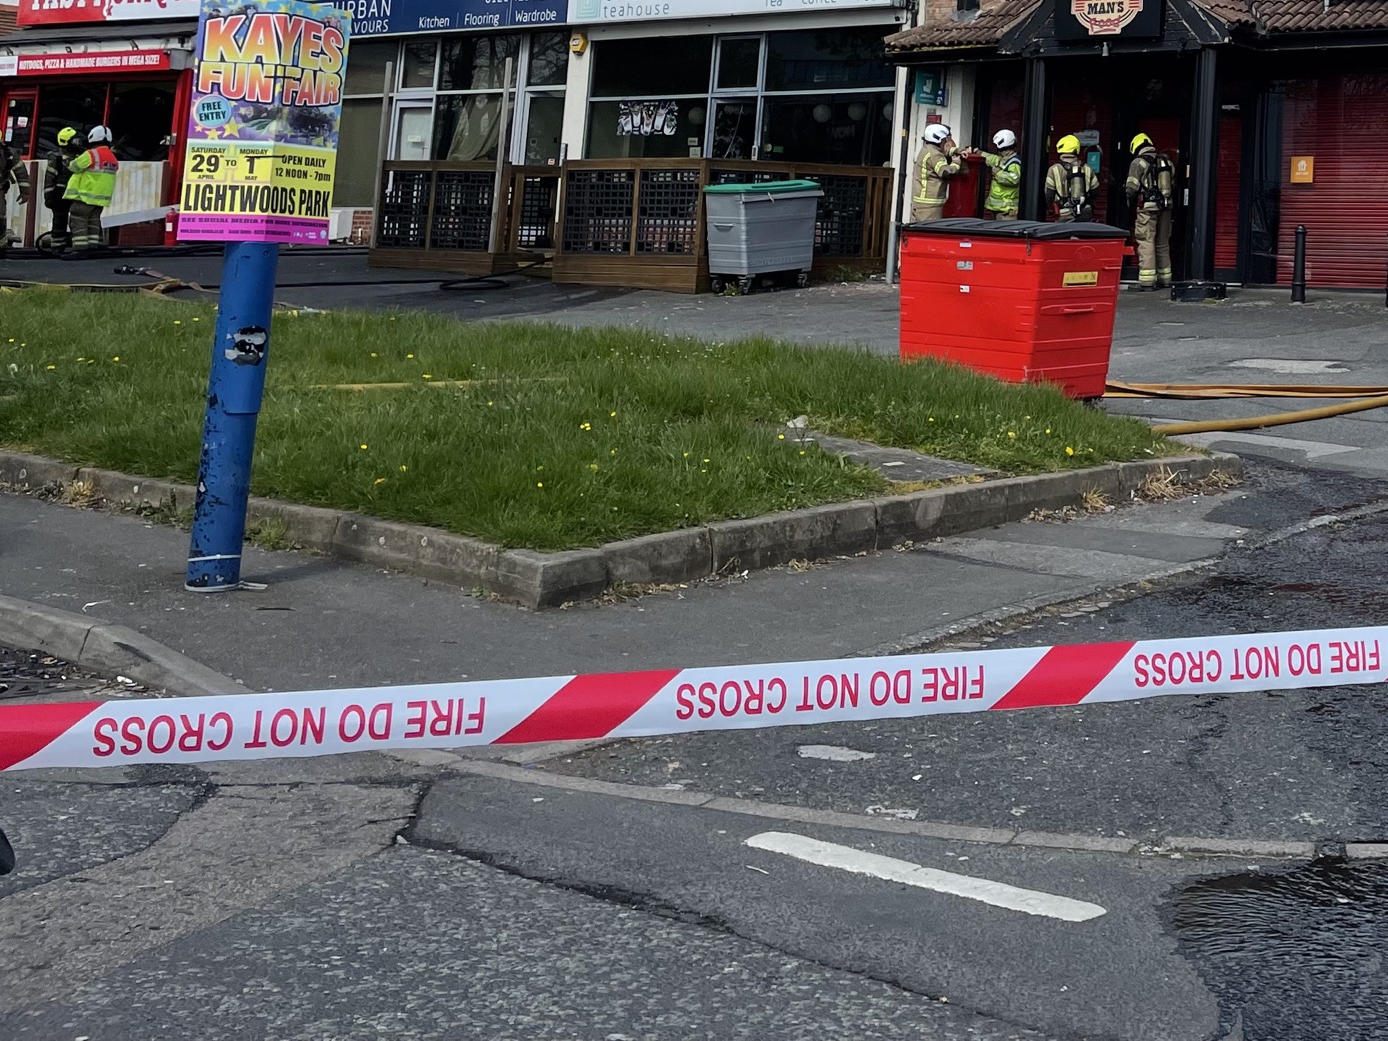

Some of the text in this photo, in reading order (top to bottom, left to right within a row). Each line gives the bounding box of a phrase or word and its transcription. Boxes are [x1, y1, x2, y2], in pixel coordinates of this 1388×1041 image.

[603, 2, 669, 19] teahouse
[1087, 1, 1124, 15] MAN'S
[419, 9, 557, 29] Kitchen Flooring Wardrobe
[203, 13, 344, 74] KAYES
[45, 59, 59, 69] PIZZA
[198, 62, 341, 106] FUN FAIR
[202, 101, 221, 110] FREE
[200, 111, 226, 122] ENTRY
[225, 159, 236, 167] TO
[282, 155, 326, 168] OPEN DAILY
[275, 167, 283, 177] 12
[285, 168, 307, 180] NOON
[314, 171, 331, 182] 7pm
[183, 184, 331, 218] LIGHTWOODS PARK
[1134, 641, 1380, 687] FIRE DO NOT CROSS
[676, 665, 984, 720] FIRE DO NOT CROSS
[93, 698, 485, 757] FIRE DO NOT CROSS
